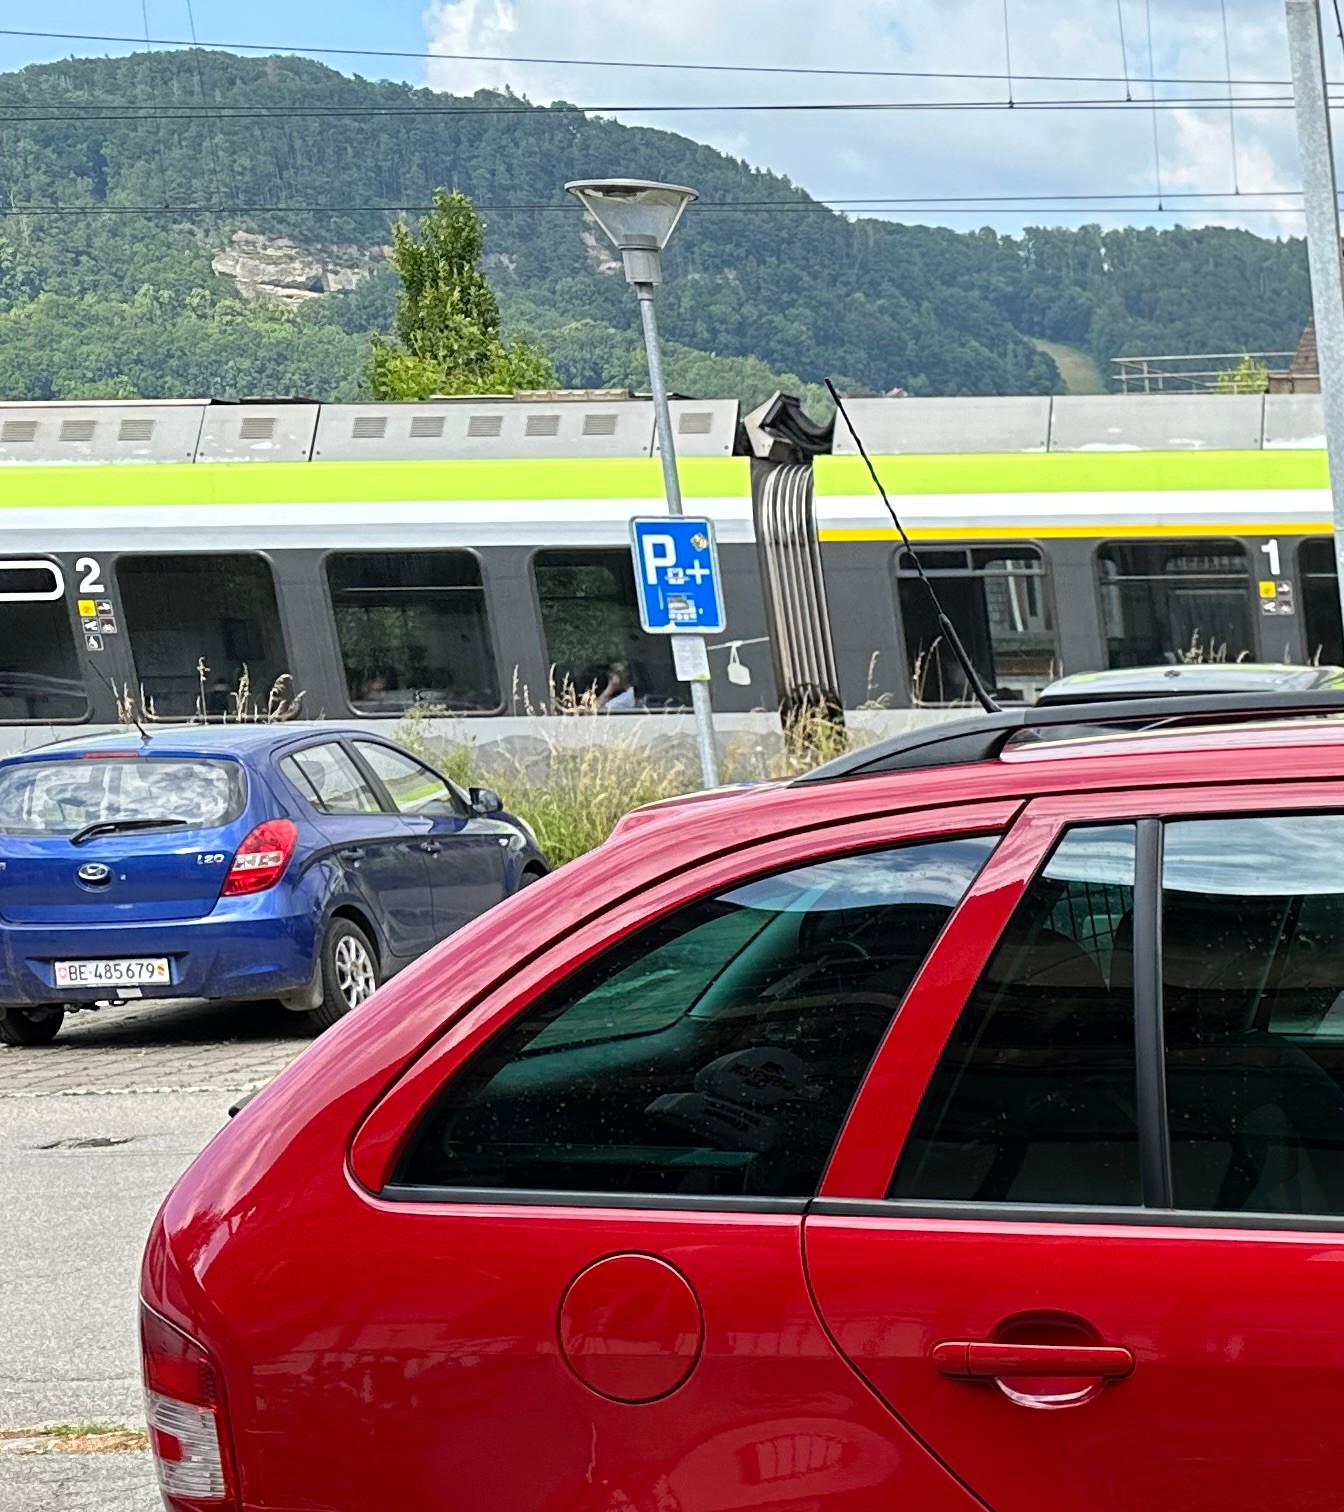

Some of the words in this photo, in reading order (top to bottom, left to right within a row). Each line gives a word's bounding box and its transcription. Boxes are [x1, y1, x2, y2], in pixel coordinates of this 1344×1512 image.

[75, 557, 105, 593] 2
[642, 534, 676, 585] P
[1260, 539, 1281, 575] 1
